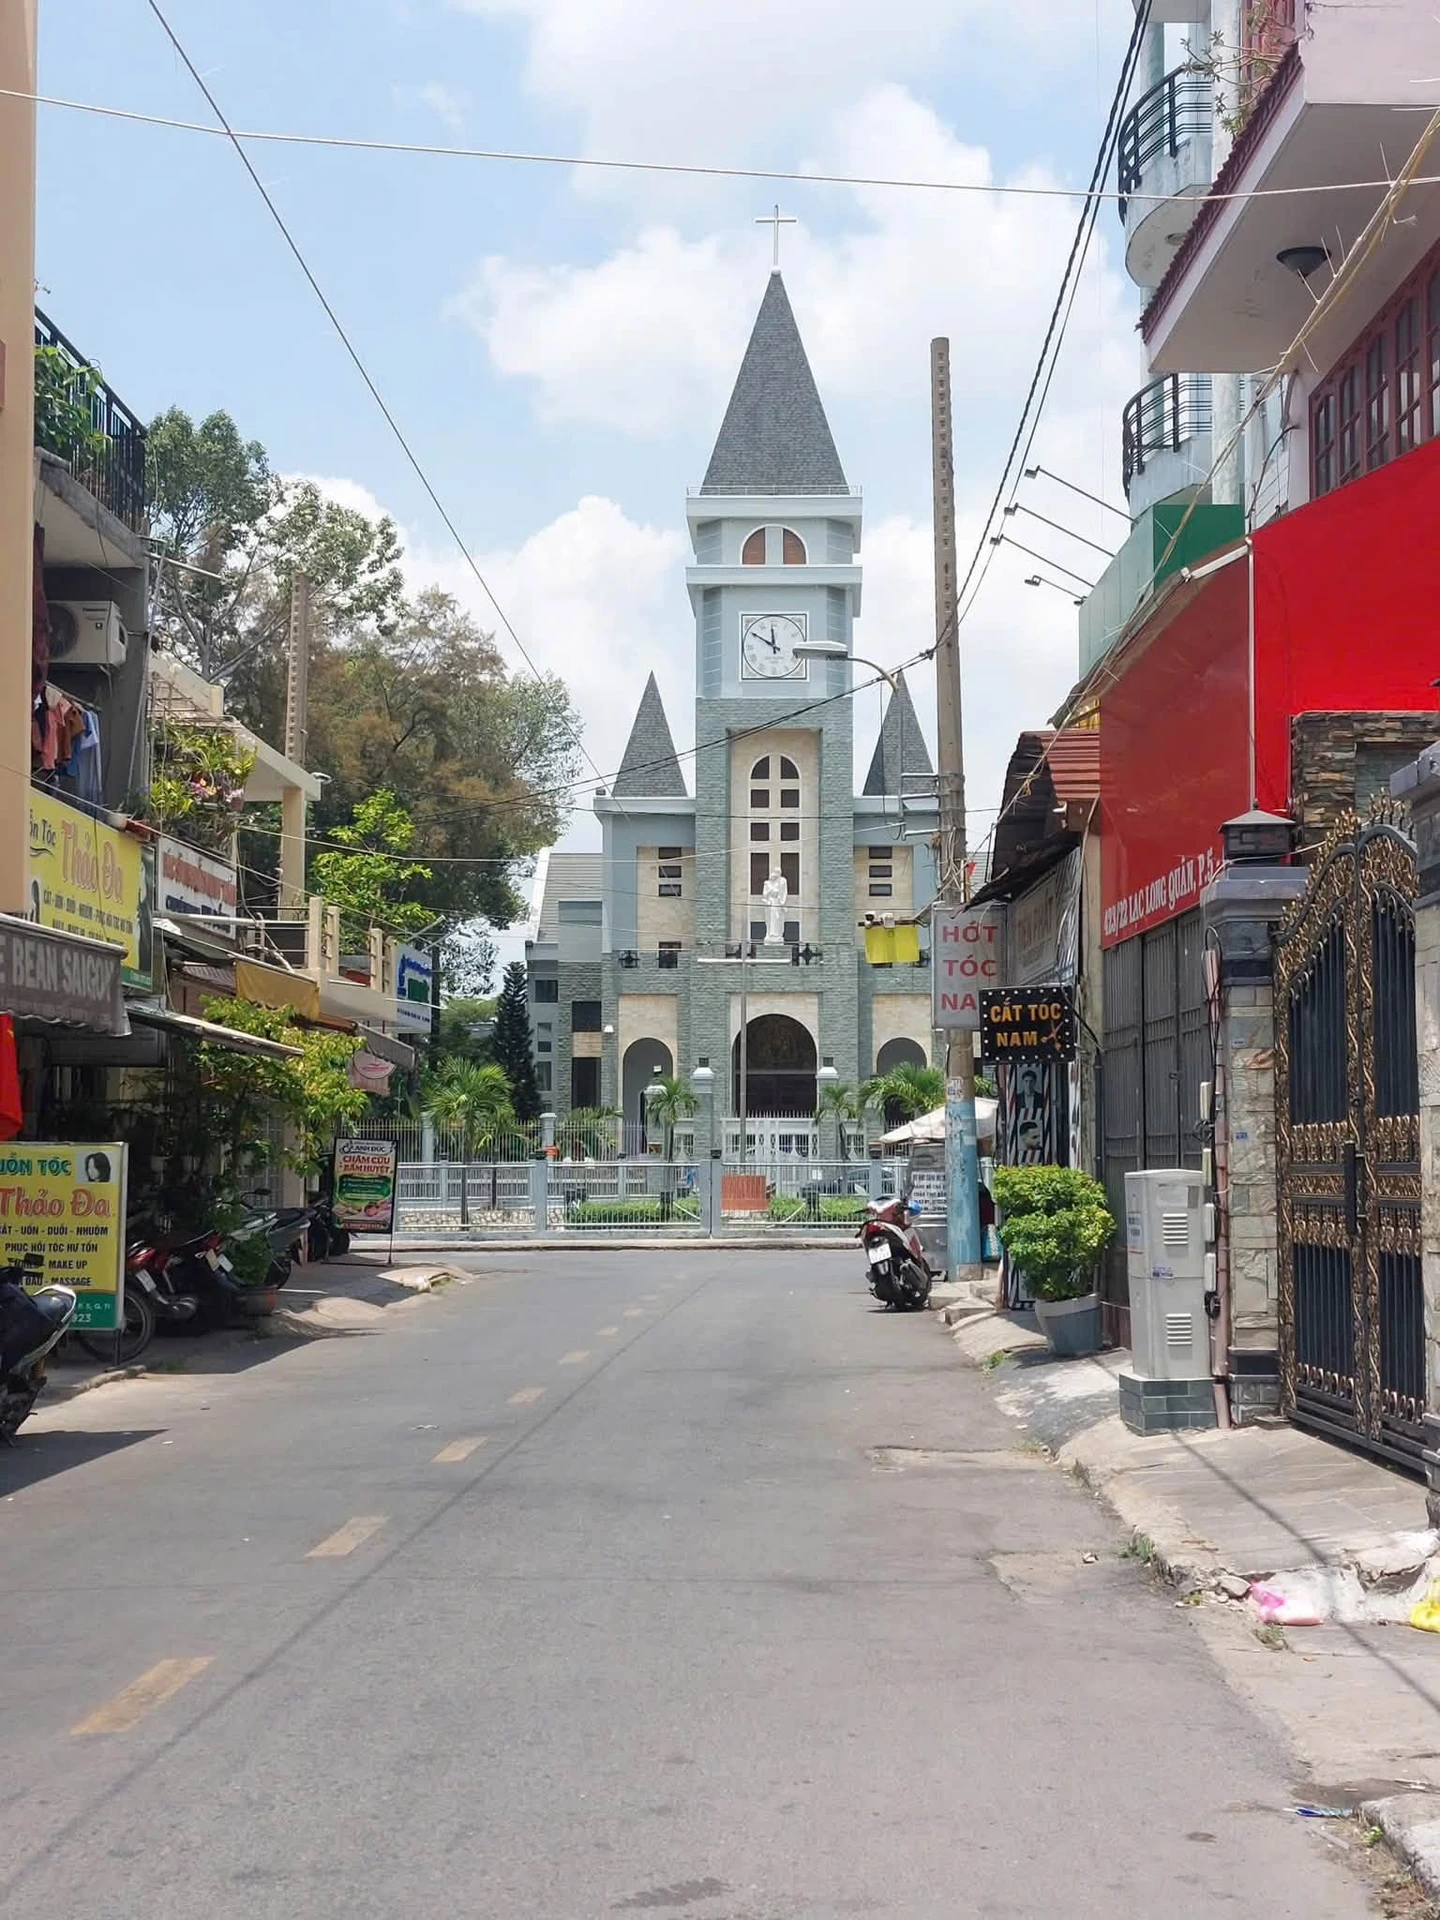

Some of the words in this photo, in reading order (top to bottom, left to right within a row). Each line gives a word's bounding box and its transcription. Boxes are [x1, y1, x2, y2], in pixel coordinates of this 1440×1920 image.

[1145, 876, 1167, 915] LONG
[942, 920, 998, 943] HỚT
[12, 936, 58, 992] BEAN
[943, 954, 998, 977] TÓC
[941, 993, 977, 1011] NA
[990, 997, 1023, 1023] CẮT
[1028, 998, 1062, 1021] TÓC
[996, 1031, 1038, 1047] NAM
[0, 1186, 64, 1218] Thảo
[48, 1259, 74, 1270] MAKE
[76, 1259, 88, 1270] UP
